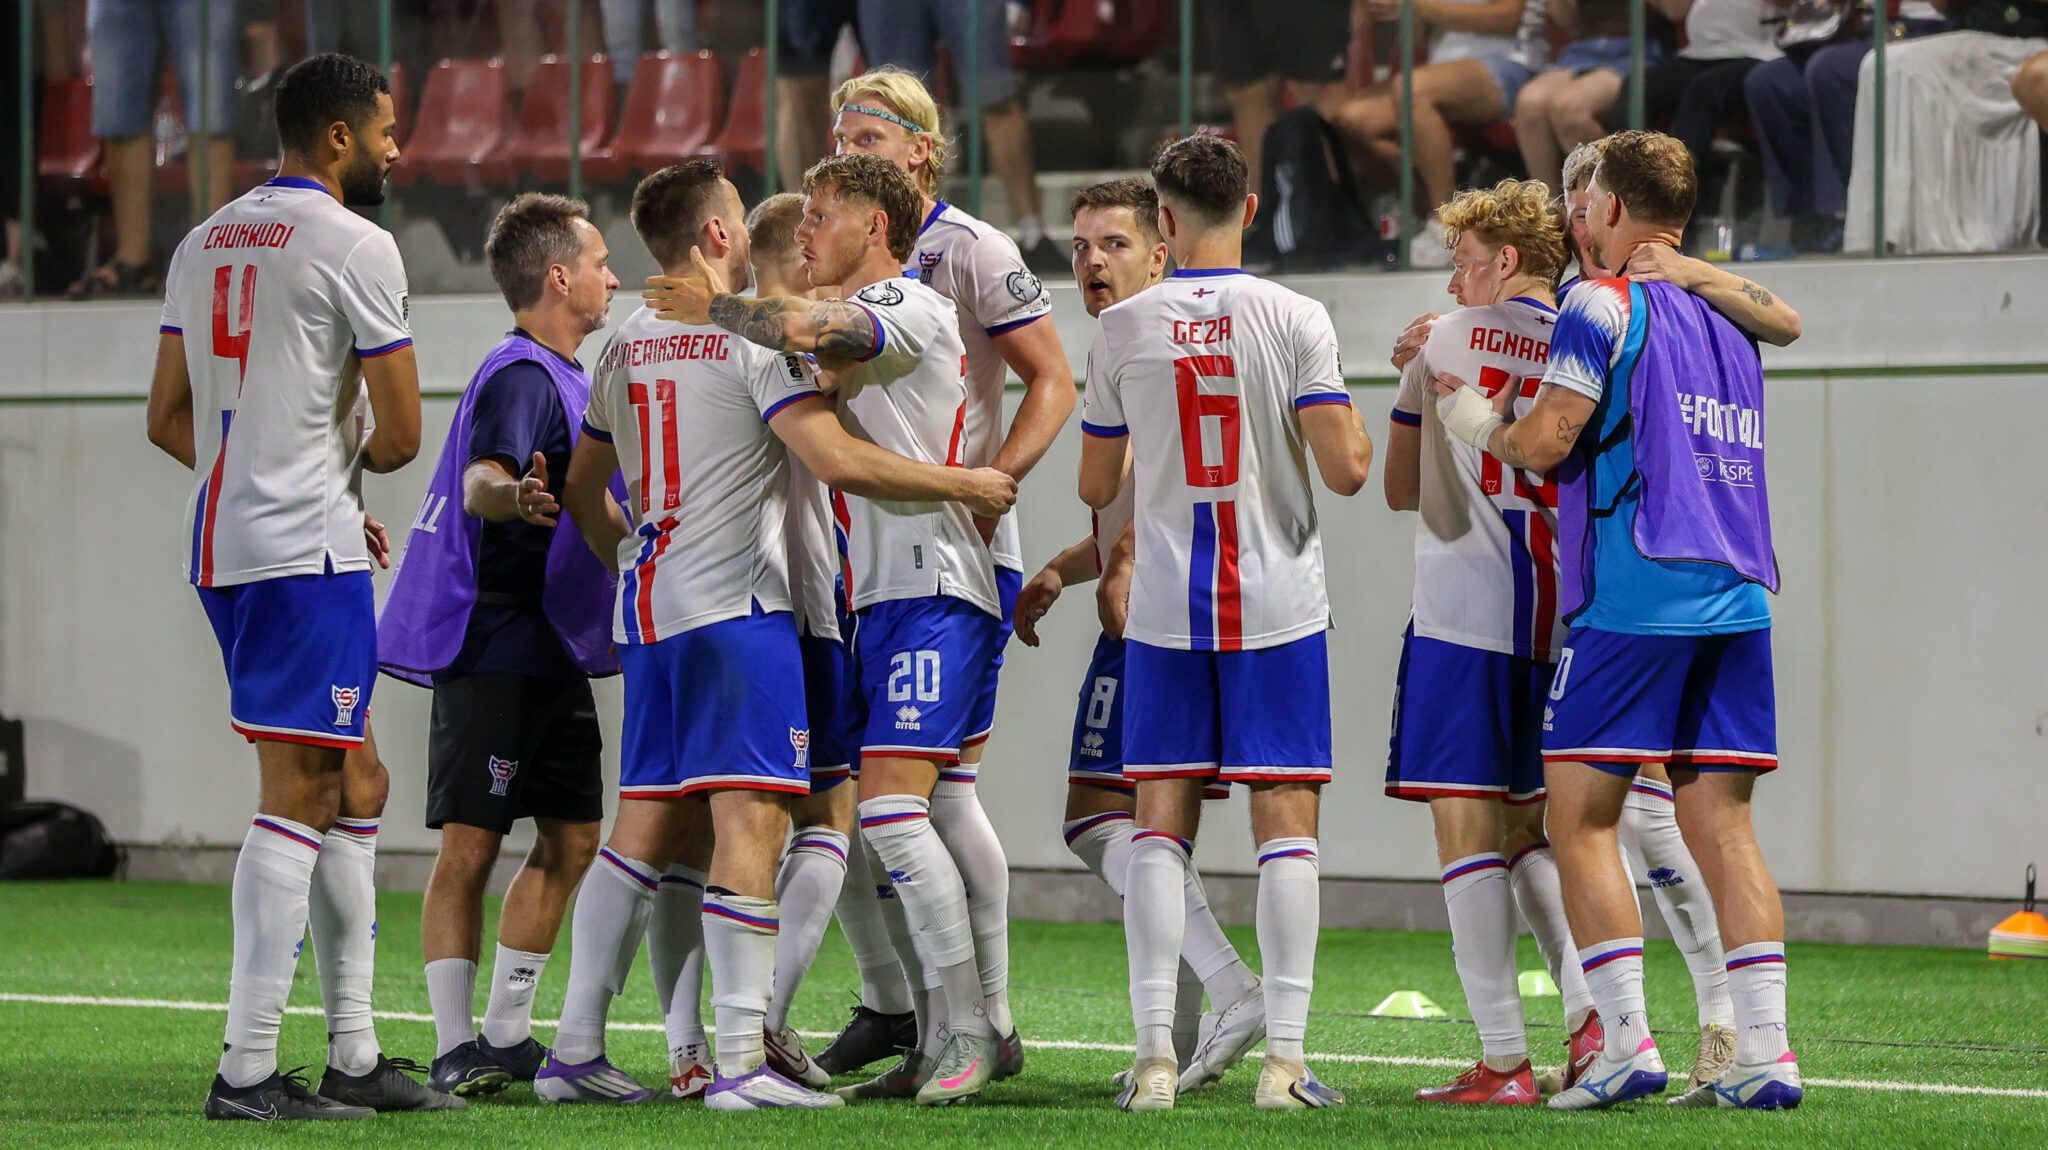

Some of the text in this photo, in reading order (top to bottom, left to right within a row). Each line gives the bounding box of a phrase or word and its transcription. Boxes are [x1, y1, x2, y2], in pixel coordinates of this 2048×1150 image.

[212, 263, 258, 400] 4
[1173, 315, 1231, 345] GEZA
[627, 378, 682, 514] 11
[1173, 354, 1240, 488] 6
[887, 649, 941, 703] 20
[1085, 676, 1119, 729] 8
